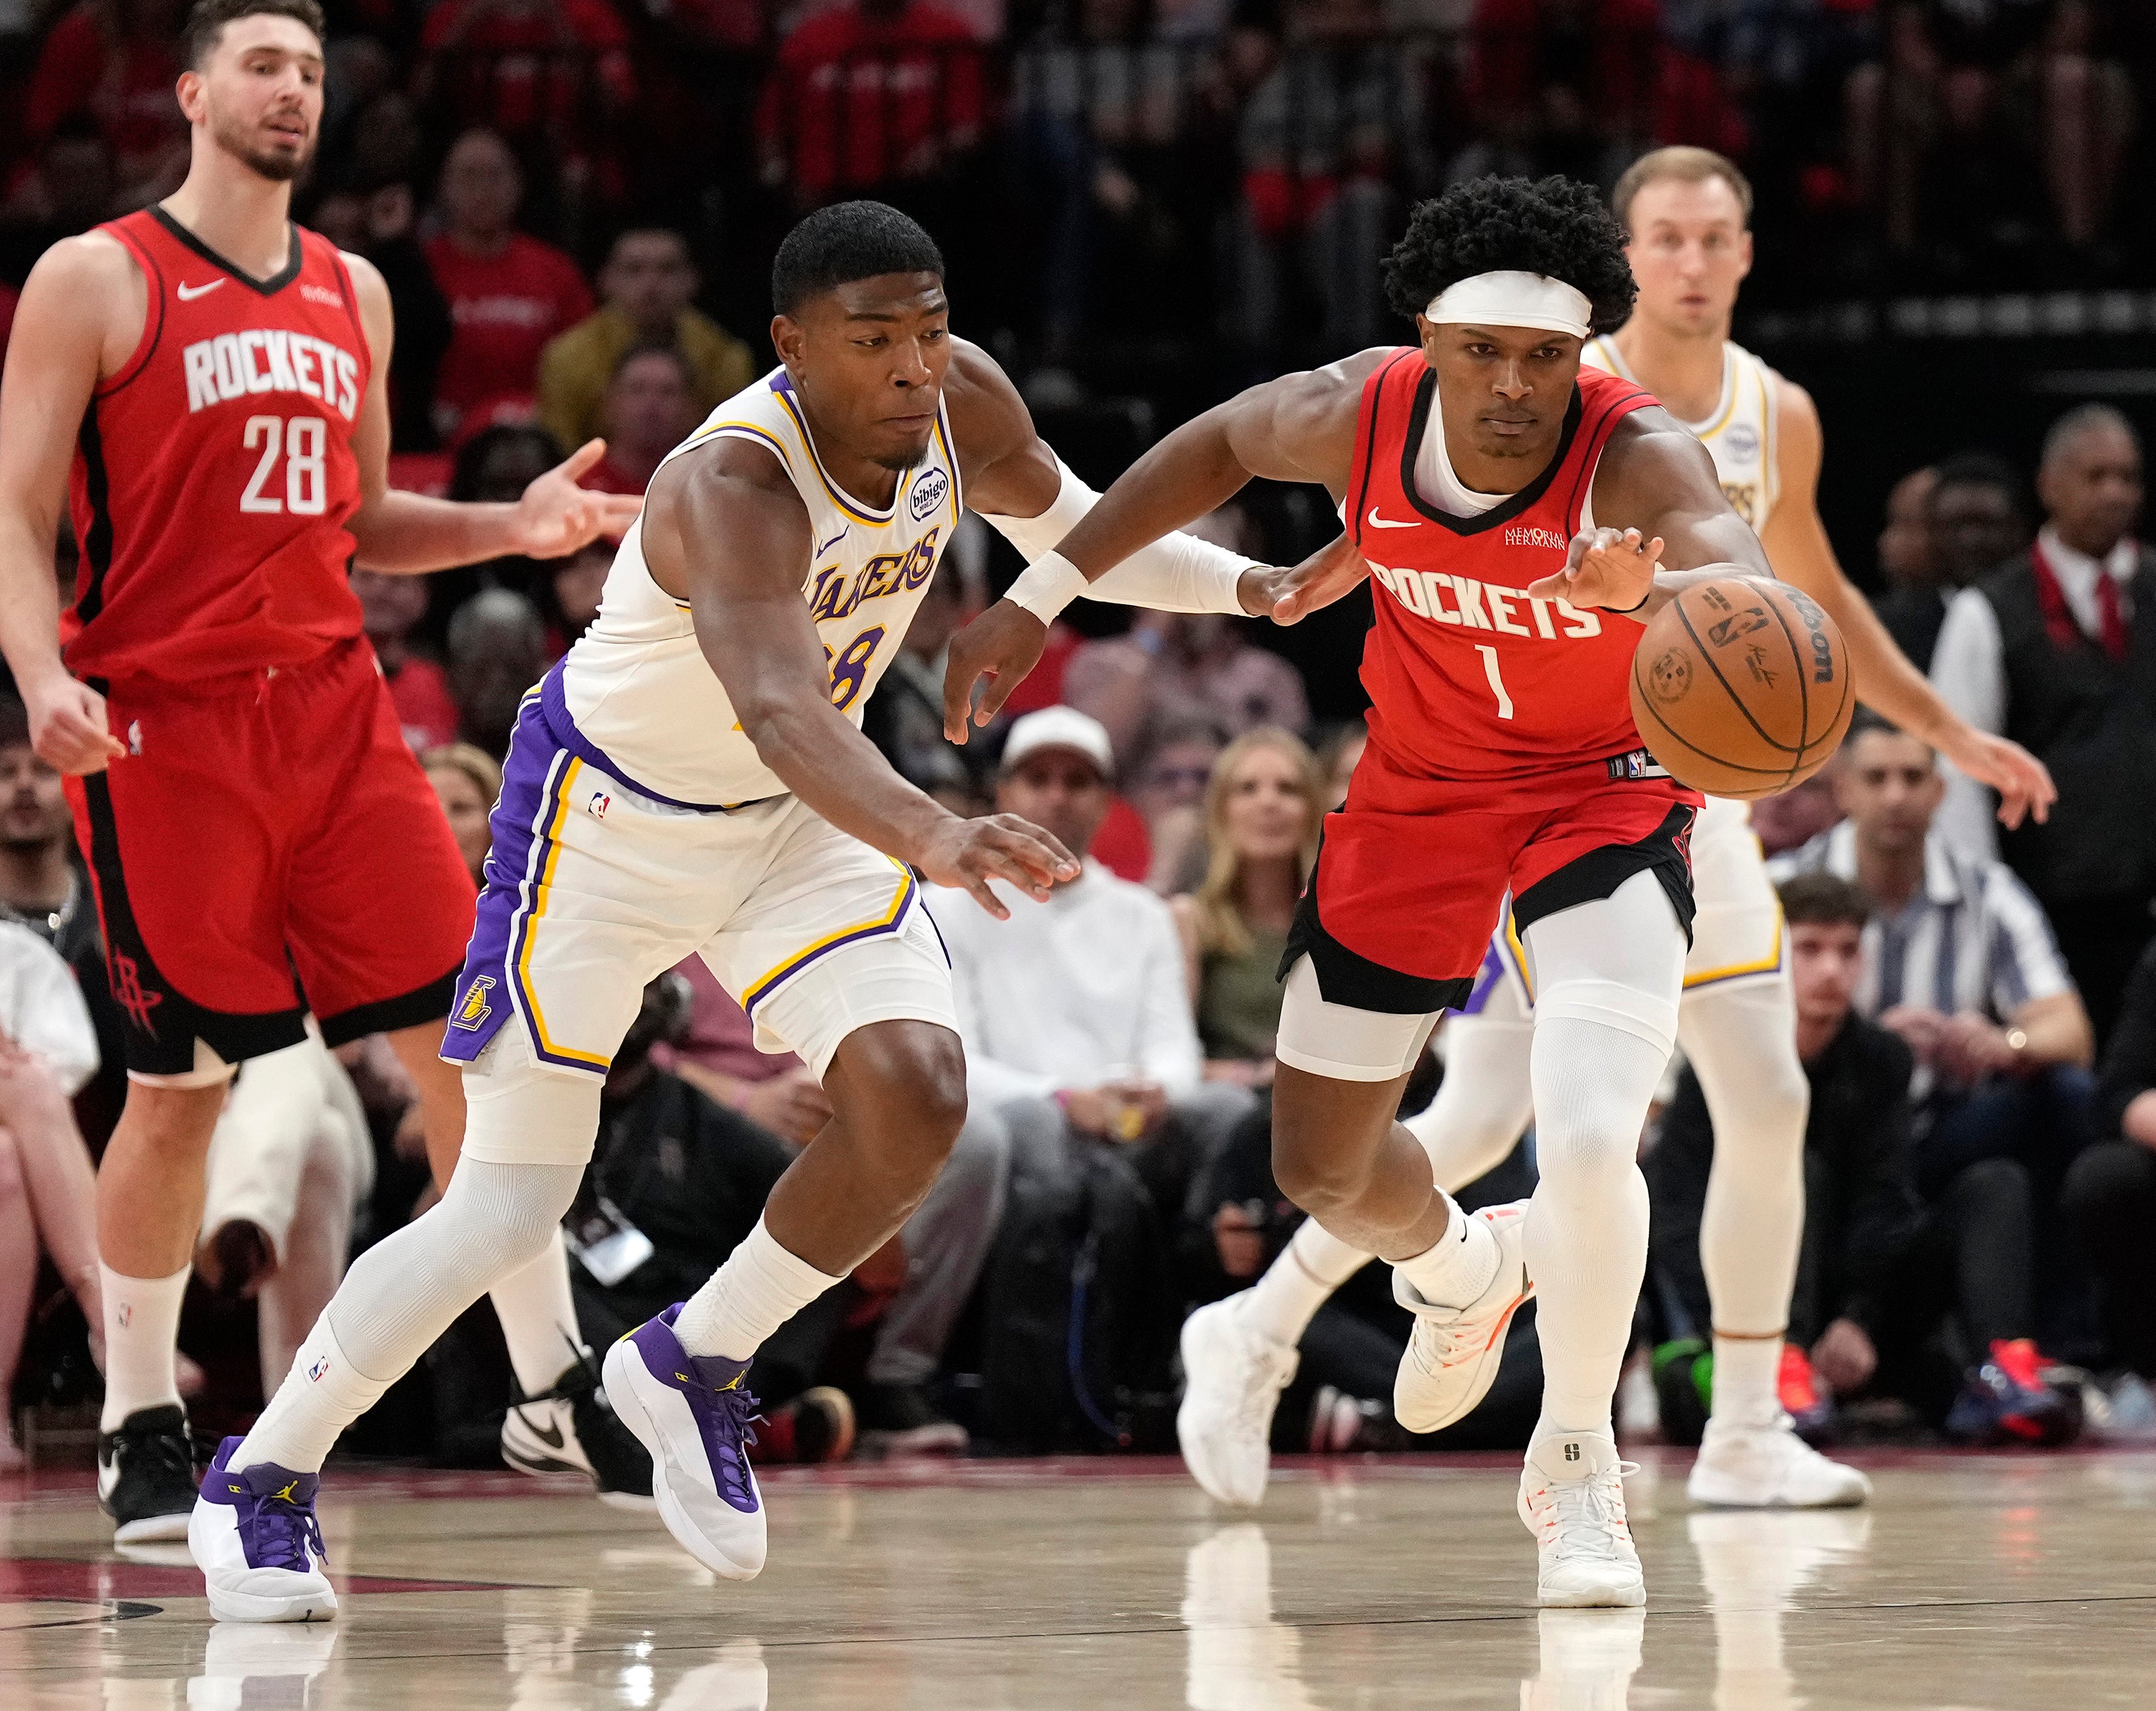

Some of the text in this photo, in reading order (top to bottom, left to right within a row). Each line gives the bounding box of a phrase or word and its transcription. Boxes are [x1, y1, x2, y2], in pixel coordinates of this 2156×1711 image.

[182, 329, 357, 421] ROCKETS
[240, 414, 325, 515] 28
[913, 480, 945, 508] bibigo
[1505, 527, 1563, 543] MEMORIAL
[1505, 536, 1565, 551] HERMANN
[822, 623, 889, 714] 8
[1474, 644, 1514, 720] 1
